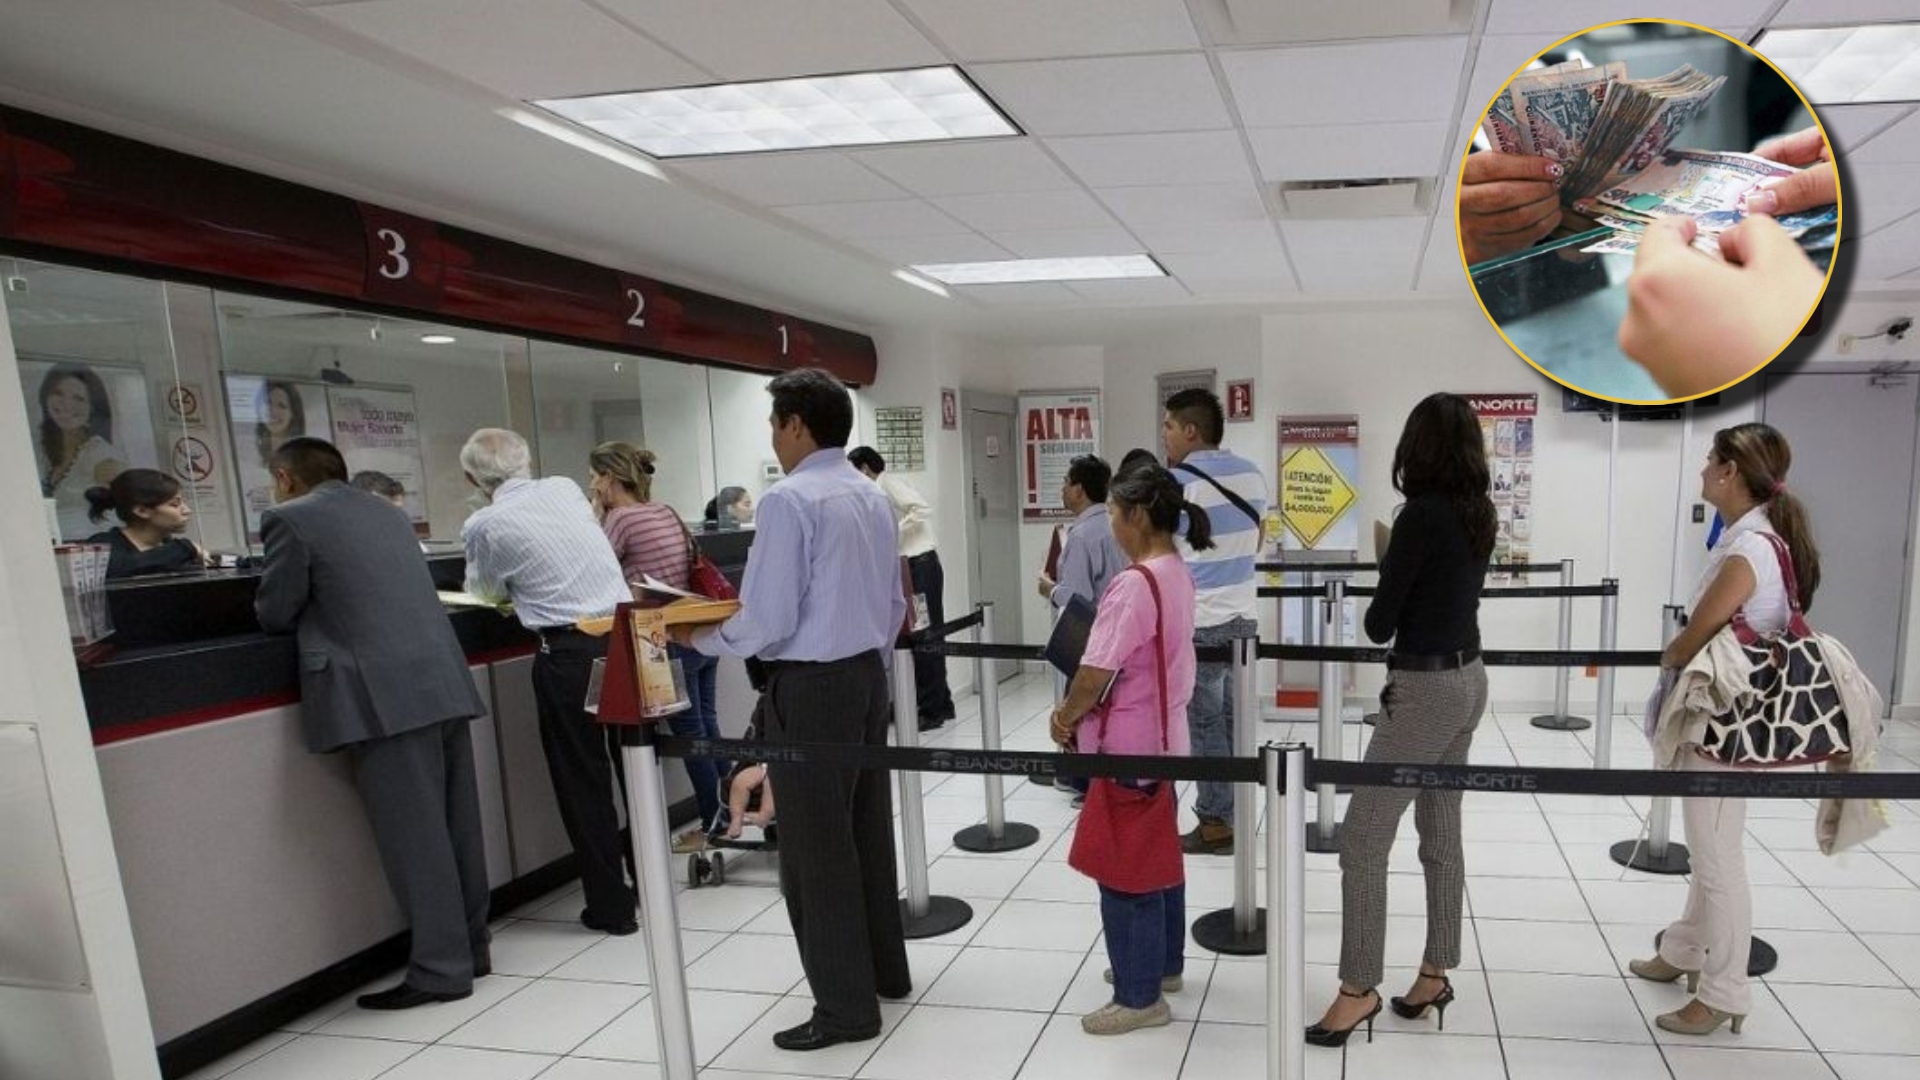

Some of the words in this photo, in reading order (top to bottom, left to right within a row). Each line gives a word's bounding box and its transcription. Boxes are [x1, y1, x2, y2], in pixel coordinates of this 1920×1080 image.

[1487, 108, 1508, 153] QUINIENTO
[377, 228, 409, 279] 3
[627, 288, 645, 328] 2
[778, 324, 789, 355] 1
[1469, 399, 1535, 412] ANORTE
[1027, 407, 1093, 440] ALTA
[954, 755, 1057, 773] BANORTE
[1422, 771, 1538, 789] BANORTE
